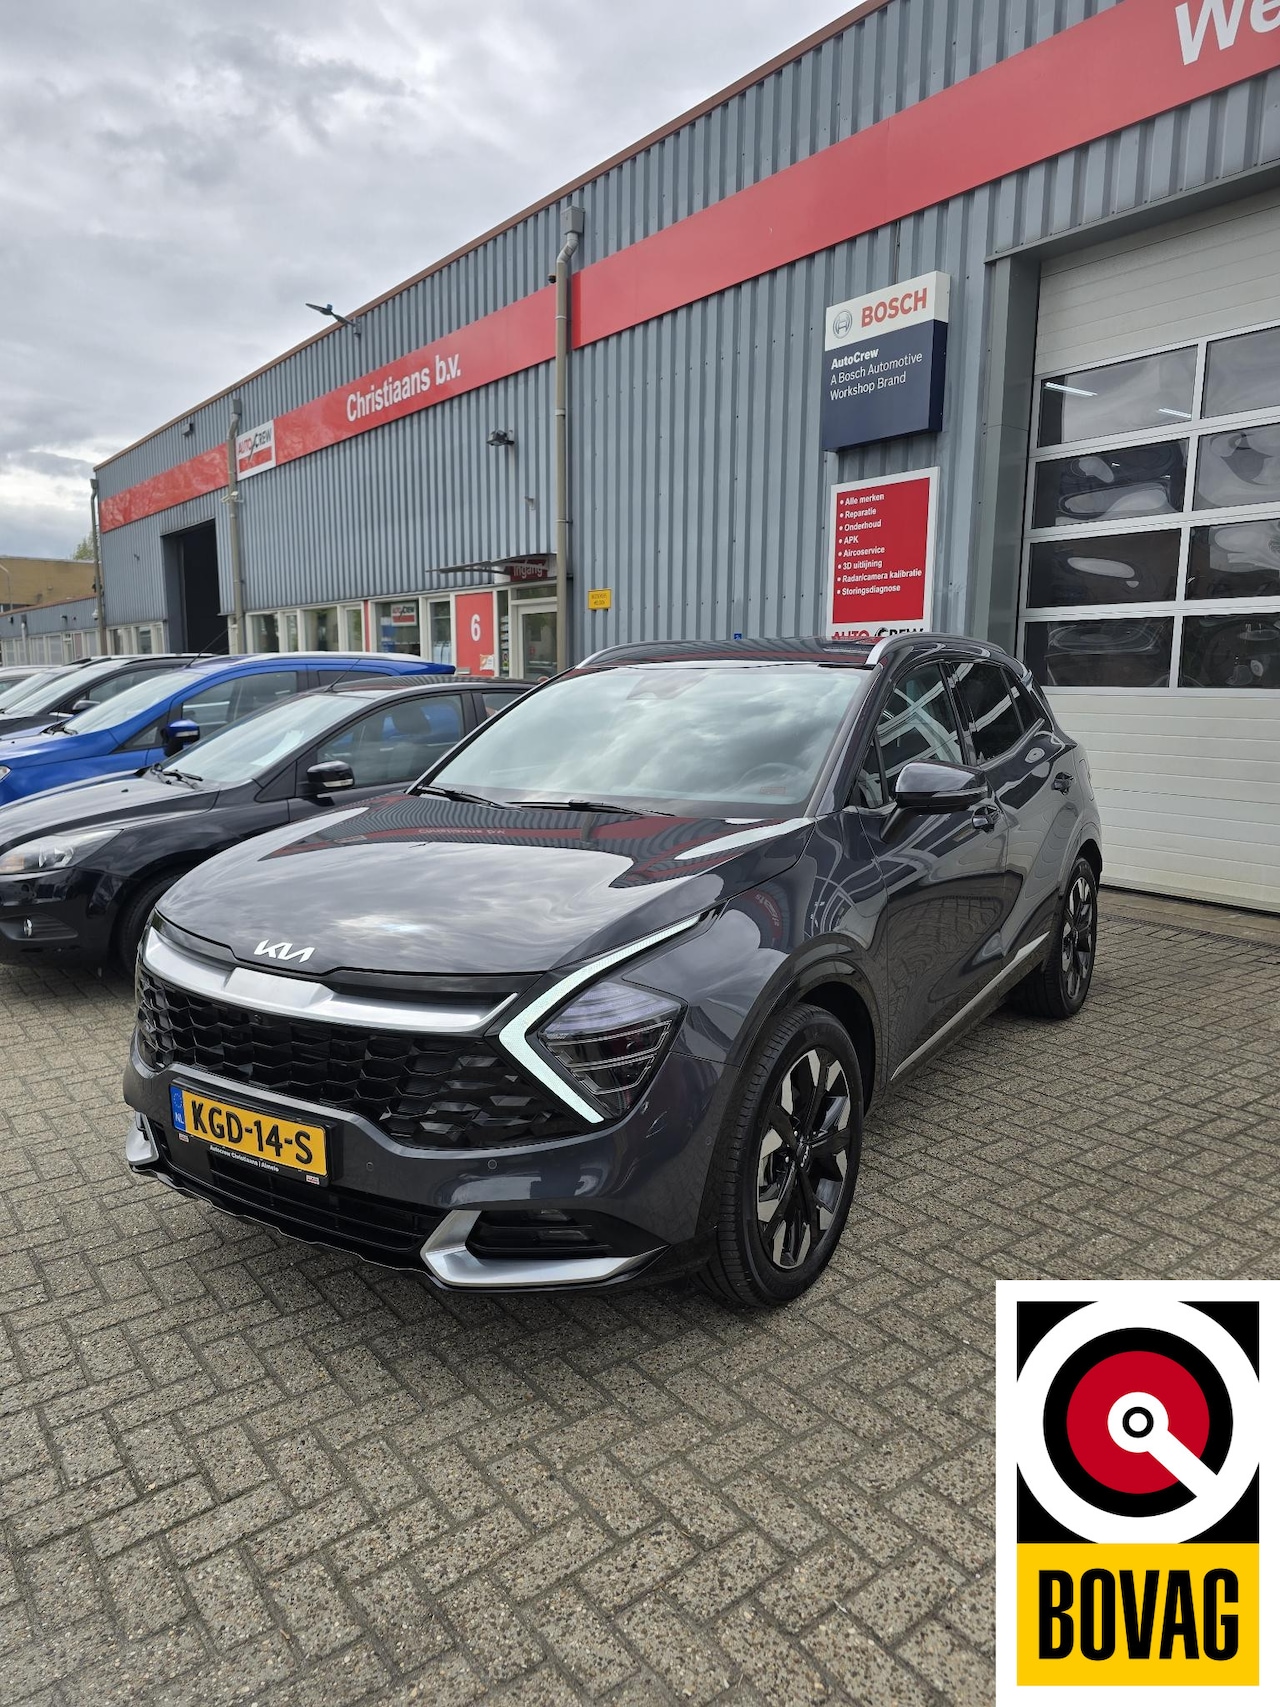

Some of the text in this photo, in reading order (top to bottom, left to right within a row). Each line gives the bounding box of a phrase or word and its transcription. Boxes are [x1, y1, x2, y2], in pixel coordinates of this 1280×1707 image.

[861, 288, 928, 328] BOSCH
[831, 348, 879, 370] AutoCrew
[830, 352, 923, 386] A Bosch Automotive
[346, 354, 461, 422] Christiaans b.v.
[830, 372, 907, 400] Workshop Brand
[844, 493, 885, 506] Alle merken
[844, 507, 877, 519] Reparatie
[844, 519, 882, 532] Onderhoud
[843, 535, 859, 545] APK
[843, 546, 885, 558] Aircoservice
[842, 560, 883, 570] 3D uitlijning
[889, 568, 922, 579] kalibratie
[842, 584, 901, 596] Storingsdiagnose
[470, 613, 481, 641] 6
[174, 1111, 185, 1125] NL
[191, 1100, 313, 1165] KGD-14-S
